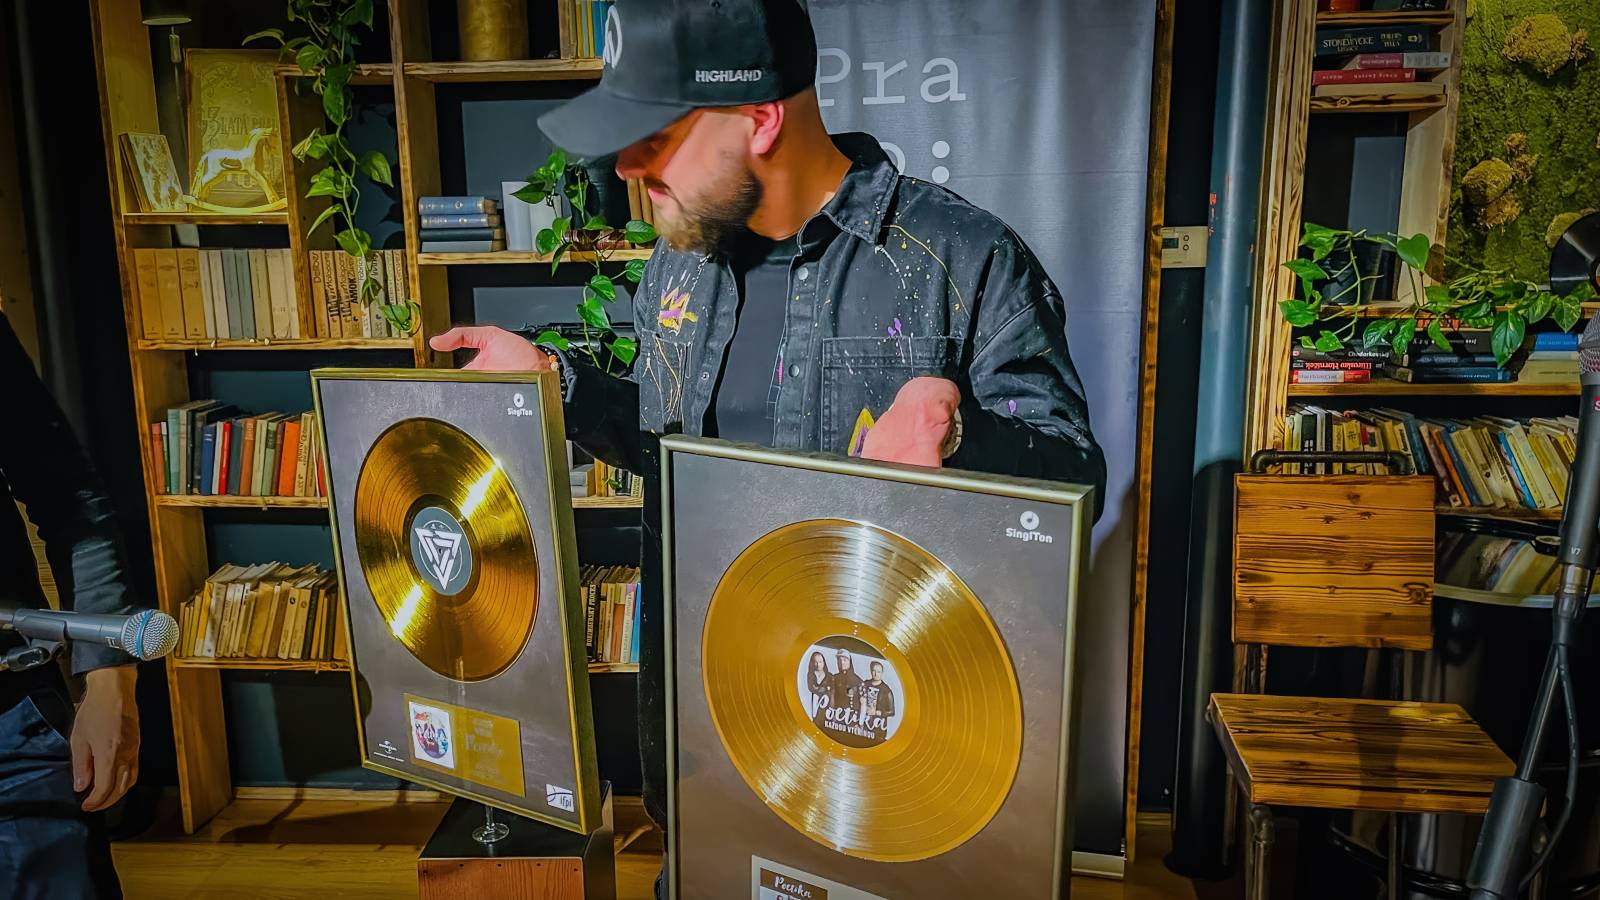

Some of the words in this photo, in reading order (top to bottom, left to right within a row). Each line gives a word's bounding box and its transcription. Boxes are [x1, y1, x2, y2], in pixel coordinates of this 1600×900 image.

[695, 70, 762, 82] HIGHLAND
[817, 47, 967, 106] Pra
[348, 277, 359, 304] AMOK
[811, 694, 888, 732] Poetika
